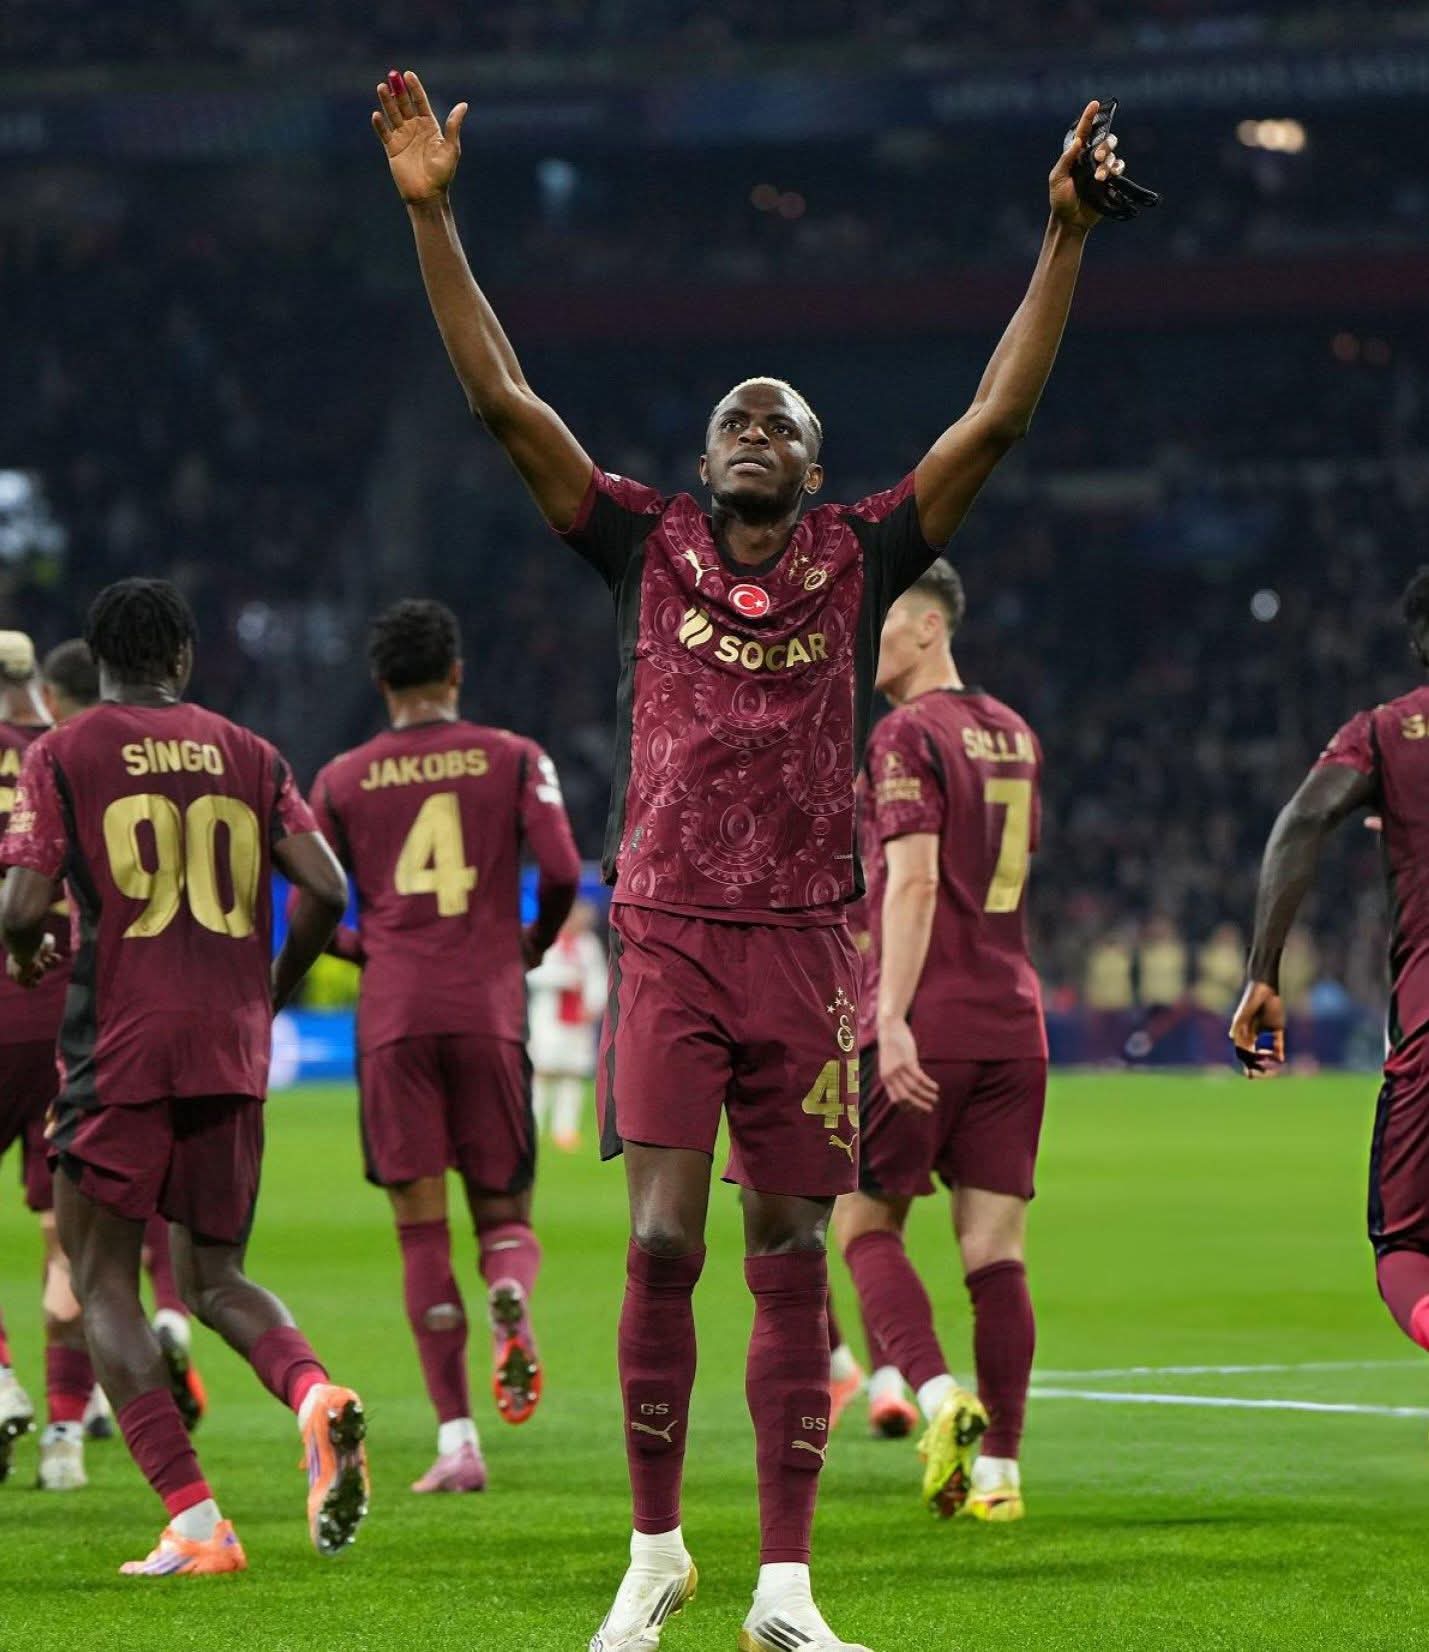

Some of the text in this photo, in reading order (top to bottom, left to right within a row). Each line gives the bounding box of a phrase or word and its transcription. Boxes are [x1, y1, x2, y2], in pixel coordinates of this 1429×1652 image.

[715, 632, 829, 671] SOCAR
[1401, 713, 1429, 740] S
[360, 748, 489, 791] JAKOBS
[103, 793, 261, 938] 90
[394, 792, 477, 918] 4
[984, 778, 1032, 913] 7
[801, 1058, 859, 1128] 4
[640, 1403, 670, 1415] GS
[801, 1416, 827, 1431] GS
